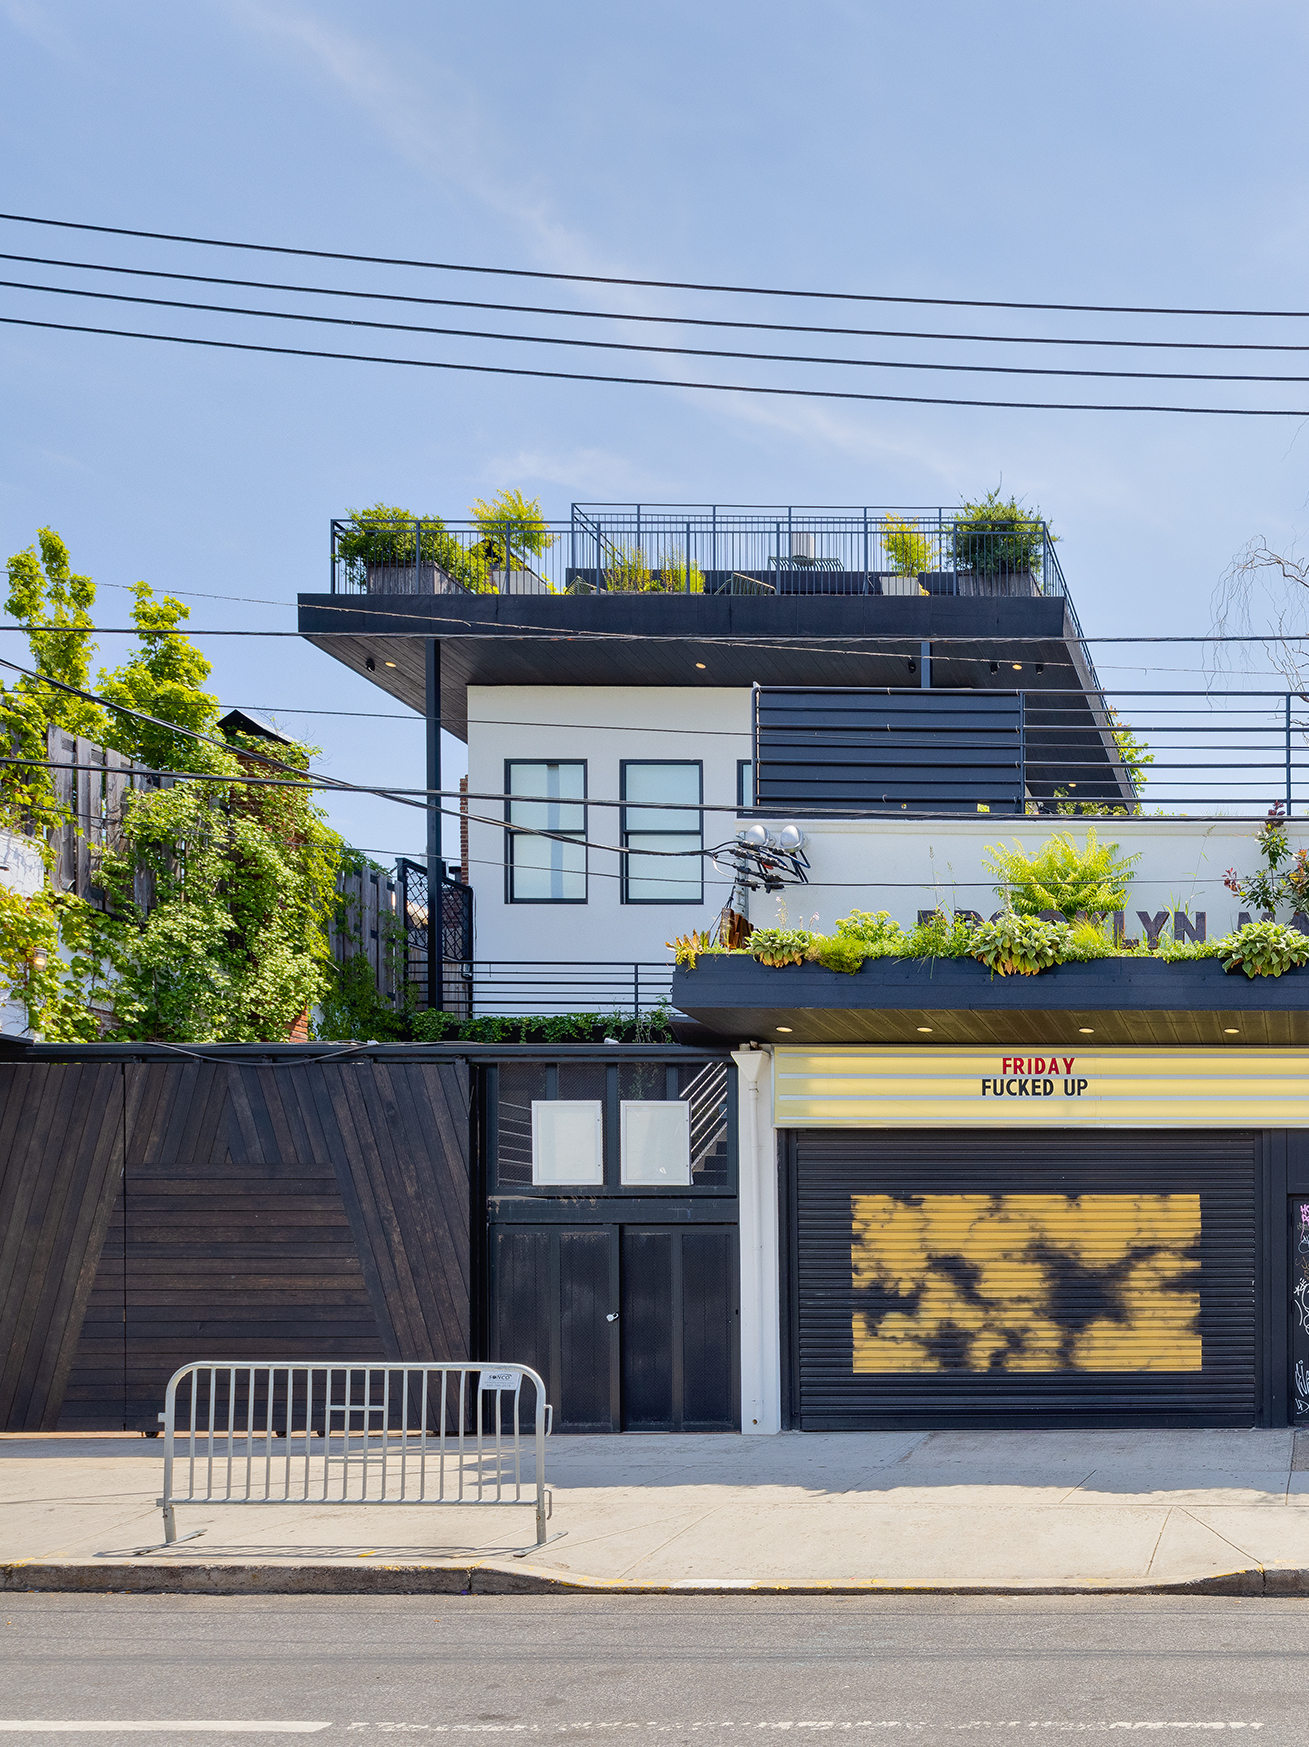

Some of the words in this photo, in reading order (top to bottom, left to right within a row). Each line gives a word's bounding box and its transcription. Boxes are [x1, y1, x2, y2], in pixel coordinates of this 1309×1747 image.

[1002, 1057, 1076, 1075] FRIDAY
[981, 1079, 1055, 1096] FUCKED
[1063, 1079, 1088, 1096] UP
